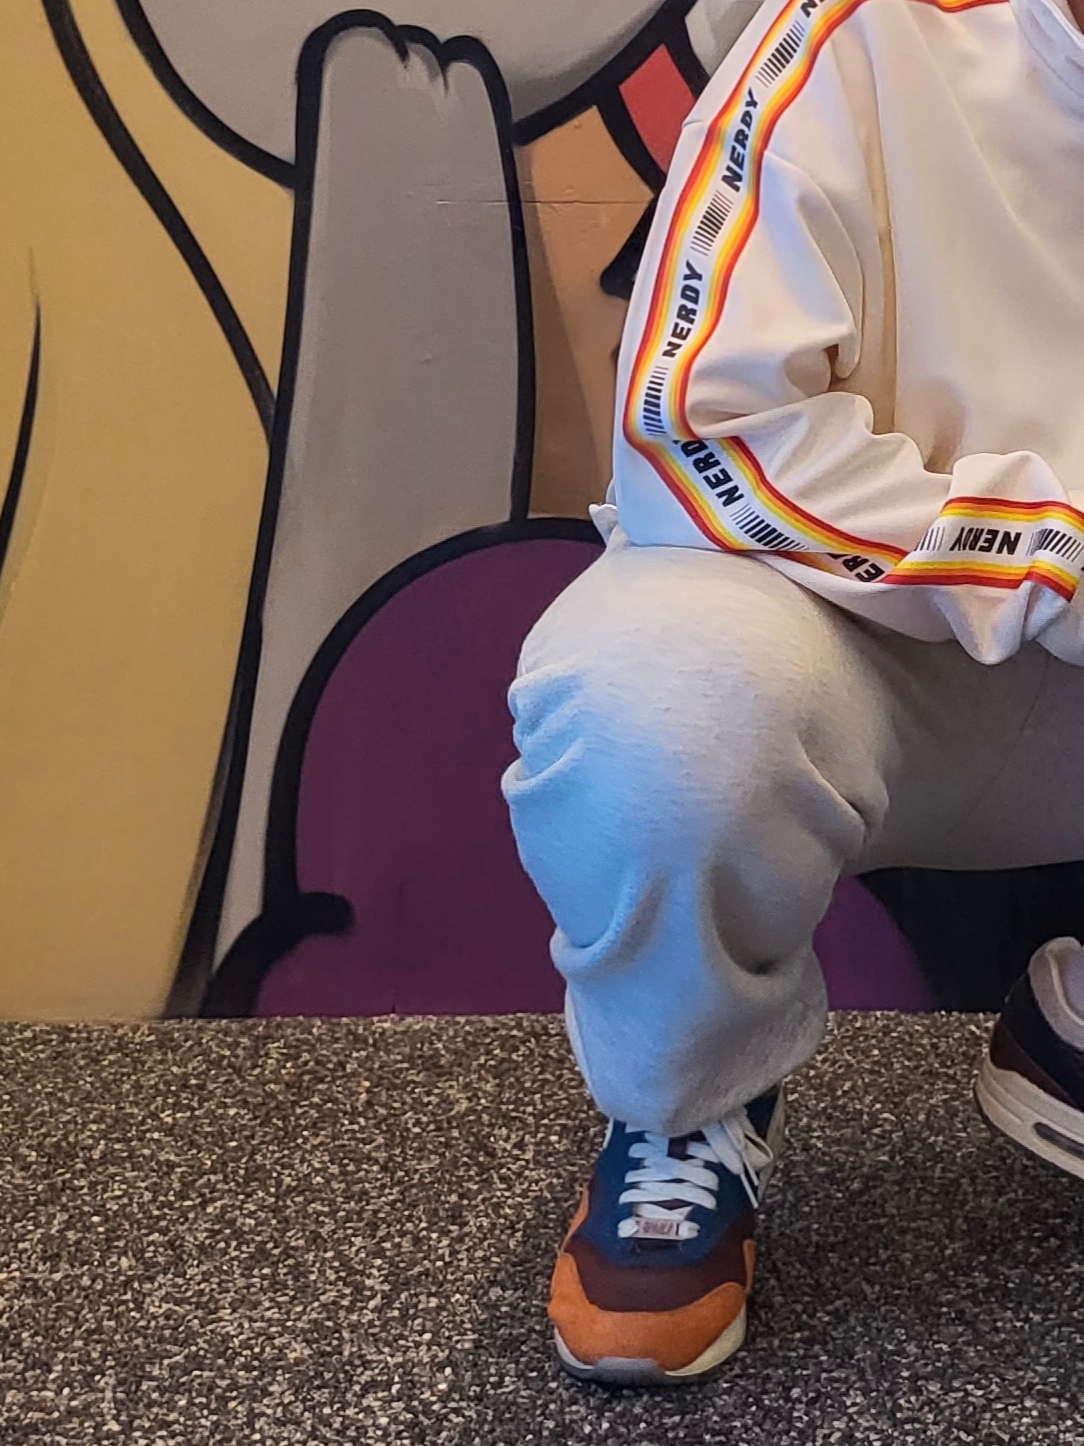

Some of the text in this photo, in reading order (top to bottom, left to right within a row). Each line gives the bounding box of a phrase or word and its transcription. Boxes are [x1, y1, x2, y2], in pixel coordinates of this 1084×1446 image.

[721, 88, 760, 193] NERDY
[662, 260, 703, 359] NERDY
[672, 439, 745, 508] NERD
[949, 526, 1022, 556] NERDY
